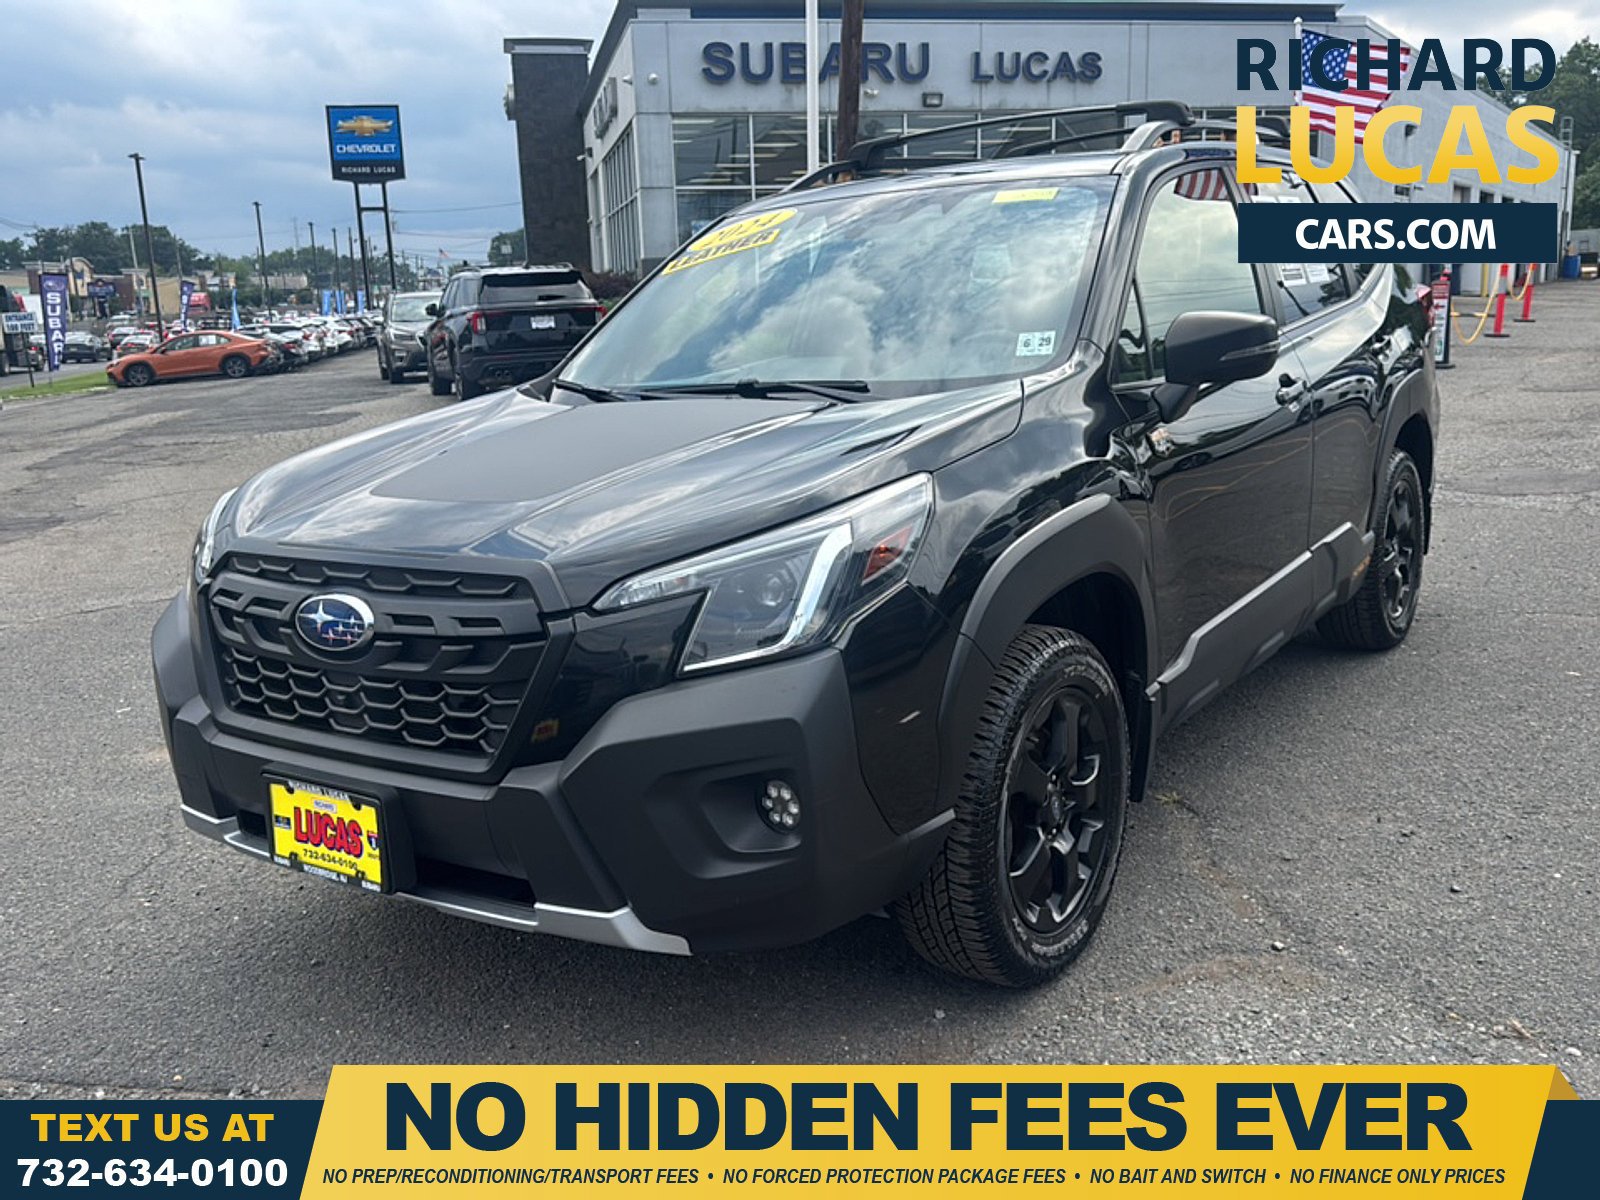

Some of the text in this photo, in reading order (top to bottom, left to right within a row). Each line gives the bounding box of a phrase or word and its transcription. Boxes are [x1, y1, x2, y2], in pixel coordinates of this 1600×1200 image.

[702, 42, 1103, 84] SUBARU LUCAS
[336, 144, 396, 154] CHEVROLET
[294, 806, 363, 858] LUCAS
